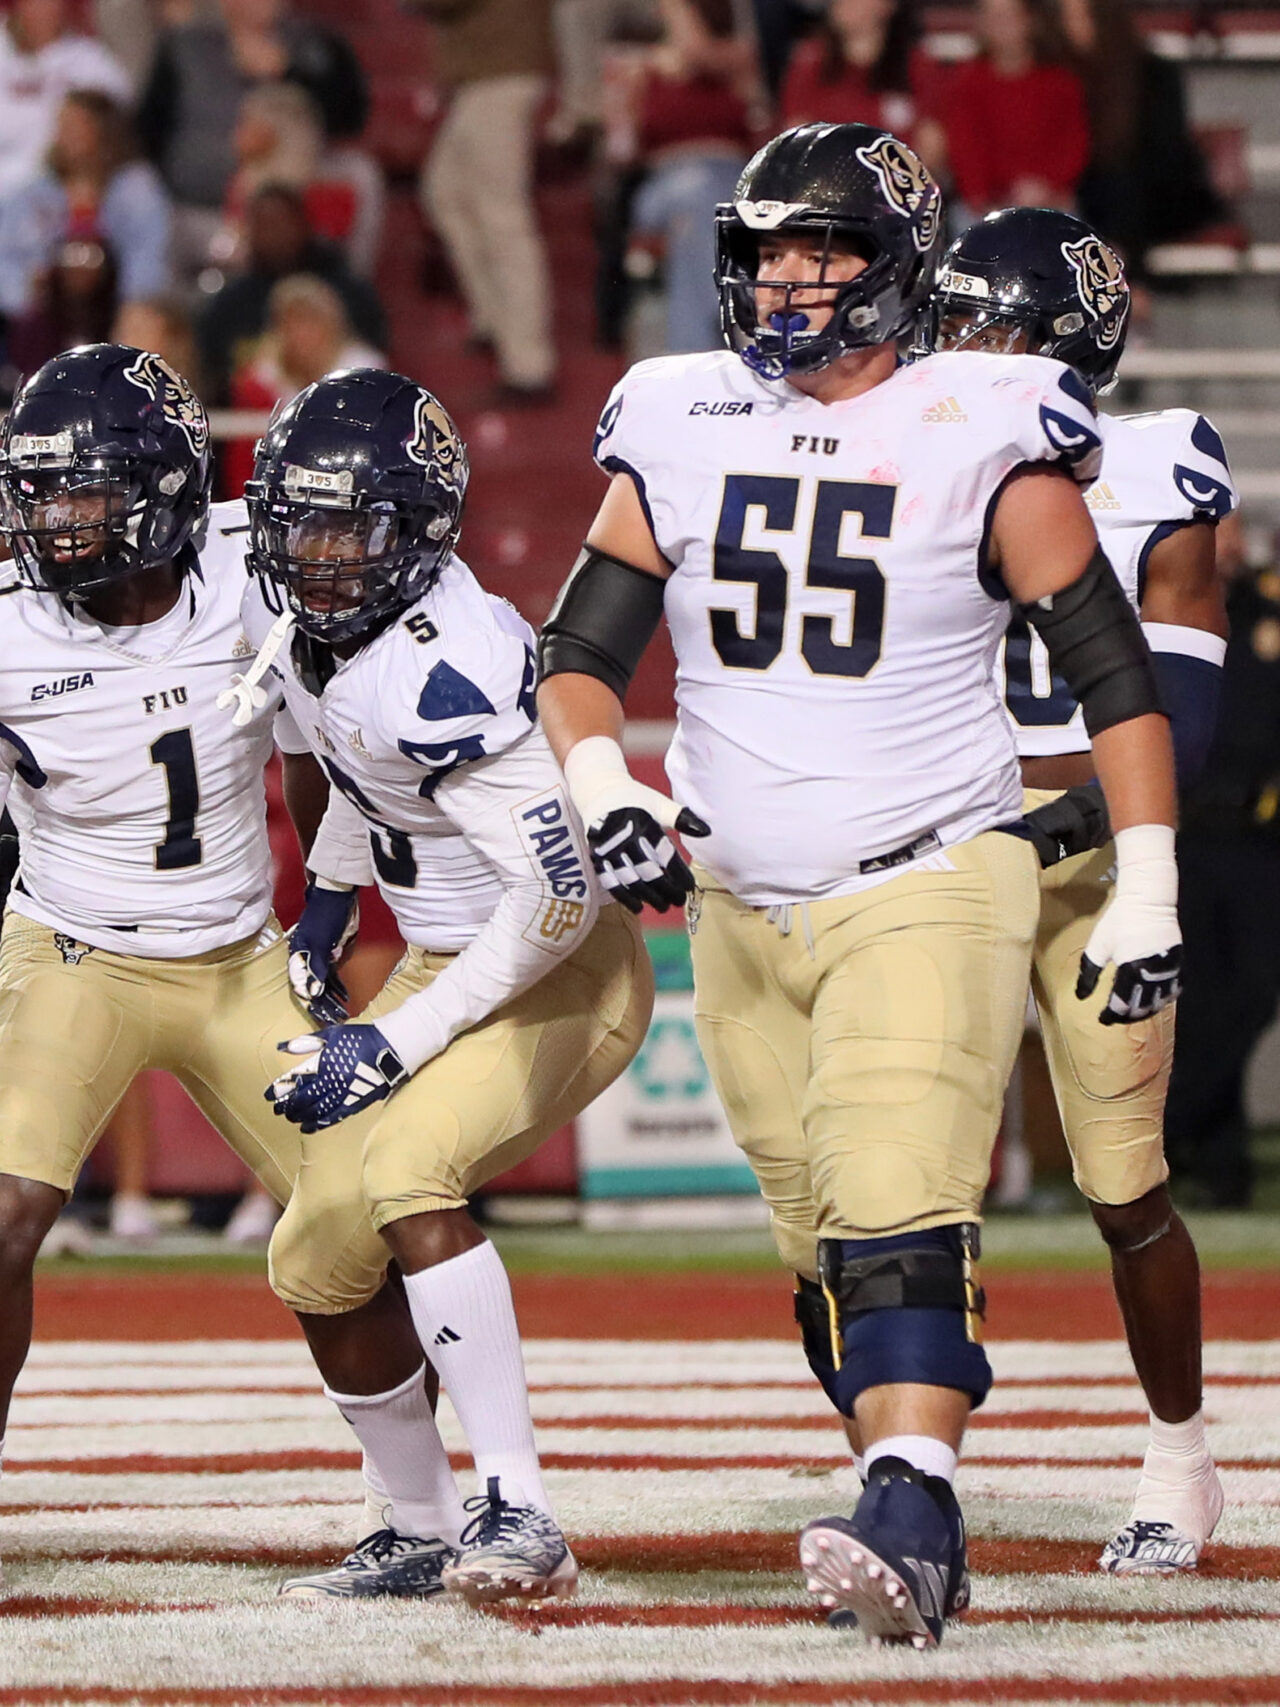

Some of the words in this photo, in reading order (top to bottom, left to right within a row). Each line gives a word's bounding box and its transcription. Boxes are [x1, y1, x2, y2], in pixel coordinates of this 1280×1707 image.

[791, 434, 840, 456] FIU
[707, 470, 901, 681] 55
[403, 611, 440, 645] 5
[142, 686, 189, 714] FIU
[148, 725, 205, 872] 1
[521, 798, 587, 898] PAWS
